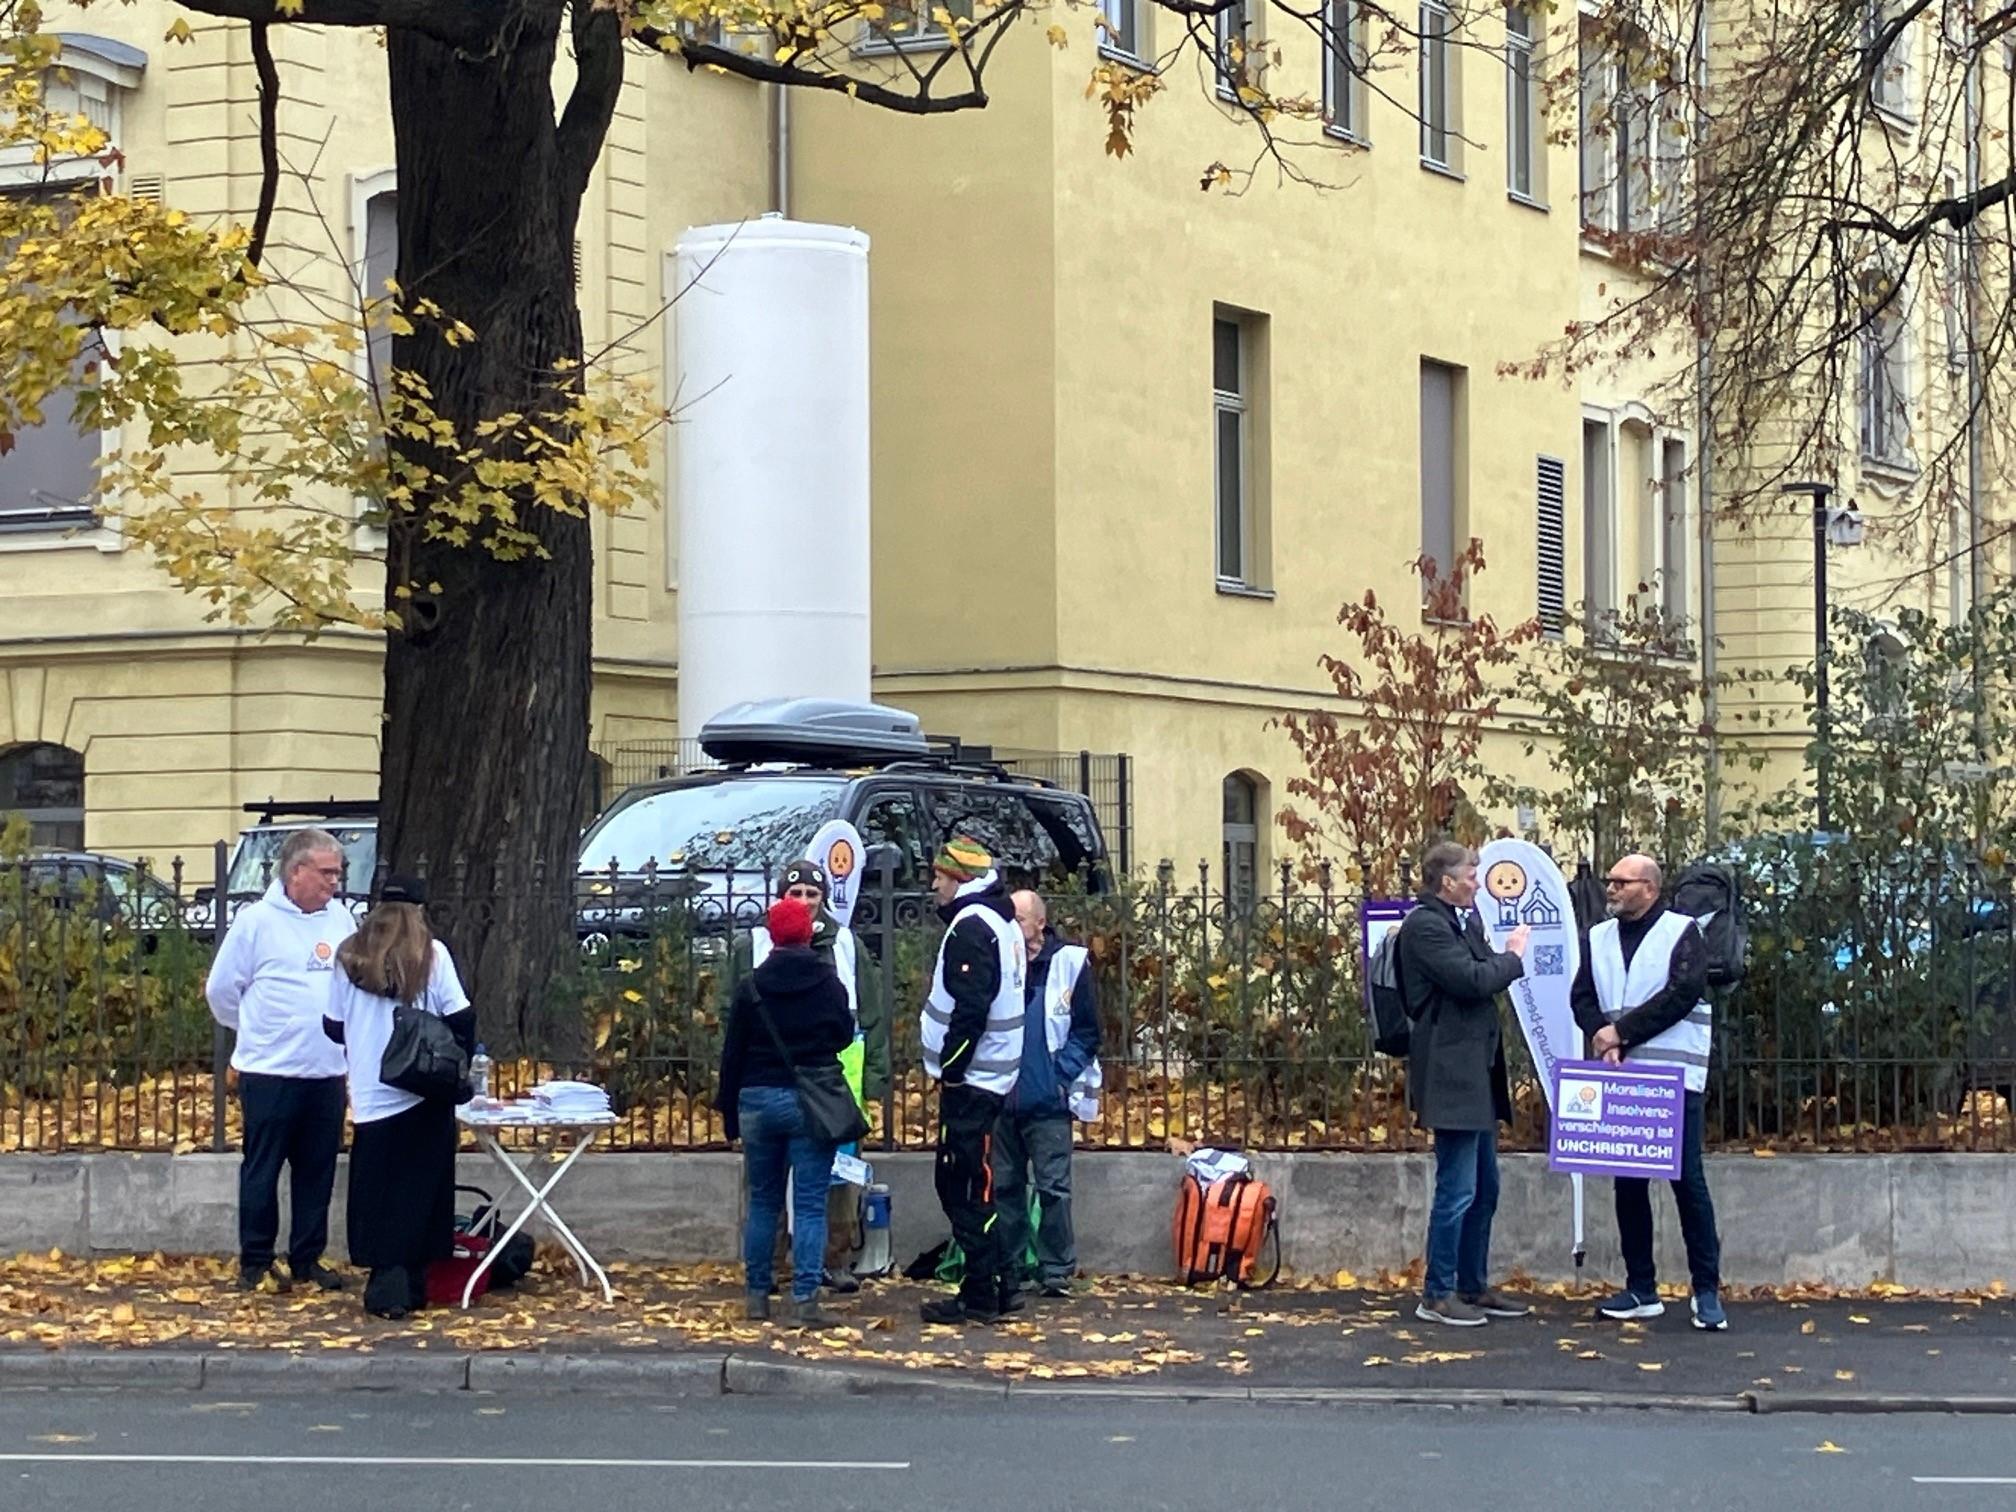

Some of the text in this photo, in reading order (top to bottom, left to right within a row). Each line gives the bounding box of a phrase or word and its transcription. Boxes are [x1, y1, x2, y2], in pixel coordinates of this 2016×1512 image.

[1607, 1102, 1674, 1118] Insolvenz-
[1657, 1125, 1674, 1138] ist
[1556, 1139, 1673, 1159] UNCHRISTLICH!
